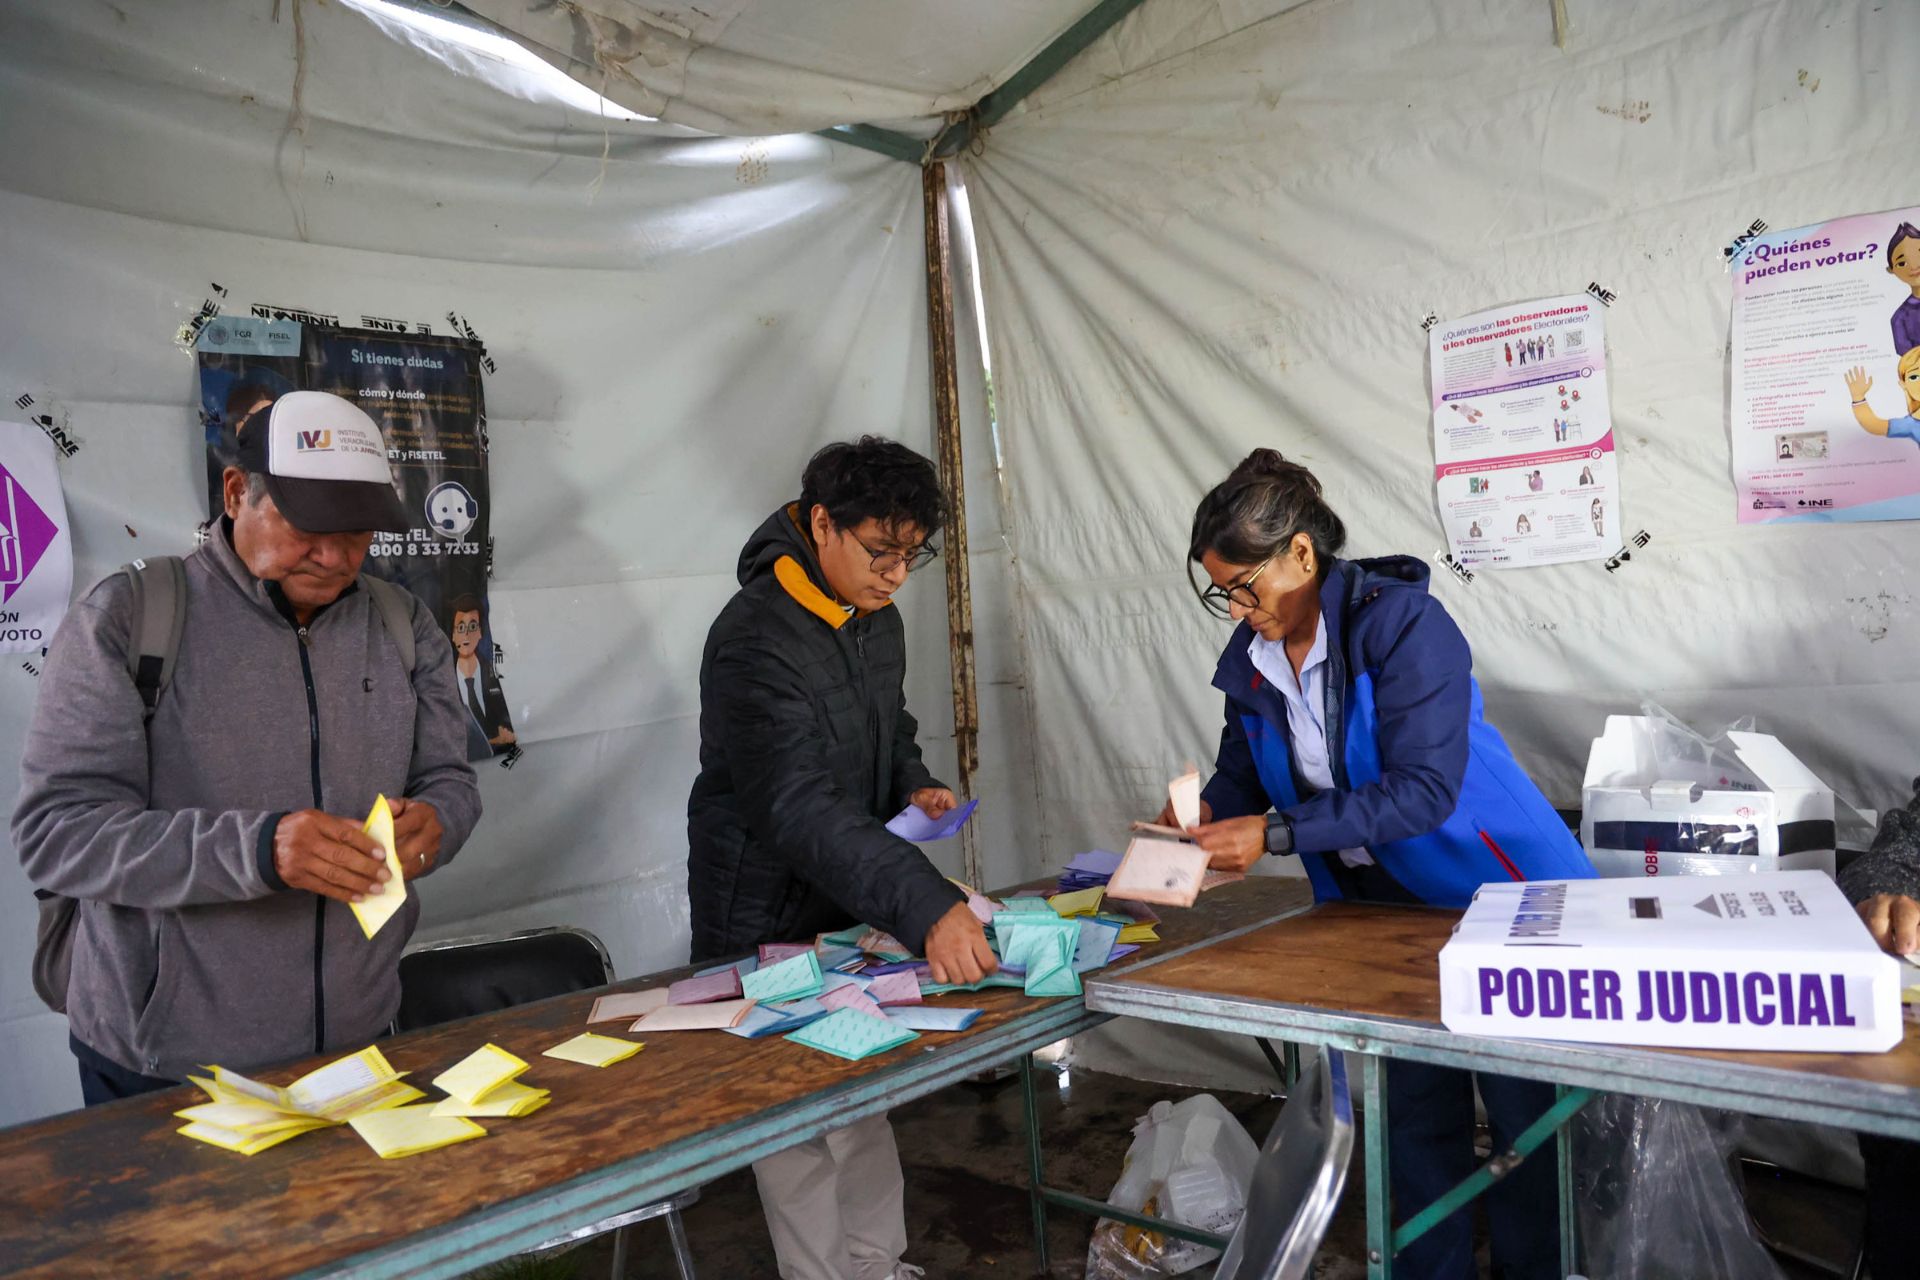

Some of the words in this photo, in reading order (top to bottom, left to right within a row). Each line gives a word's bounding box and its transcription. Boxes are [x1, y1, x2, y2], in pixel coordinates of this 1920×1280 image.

[1744, 237, 1832, 266] ¿Quiénes
[1745, 258, 1811, 284] pueden
[1815, 243, 1878, 268] votar?
[1587, 281, 1617, 304] INE
[1480, 322, 1496, 332] son
[1496, 318, 1512, 328] las
[1512, 304, 1589, 324] Observadoras
[1450, 338, 1465, 349] los
[1466, 325, 1533, 346] Observadores
[351, 348, 363, 364] Si
[366, 352, 404, 367] tienes
[406, 356, 444, 369] dudas
[358, 386, 387, 398] cómo
[388, 390, 395, 400] y
[396, 388, 426, 400] dónde
[50, 426, 80, 457] INE
[296, 429, 331, 450] IVJ
[369, 544, 402, 556] 800
[407, 543, 418, 556] 8
[422, 543, 441, 555] 33
[463, 542, 480, 554] 33
[1452, 562, 1475, 583] INE
[1478, 966, 1623, 1021] PODER
[1636, 970, 1856, 1027] JUDICIAL
